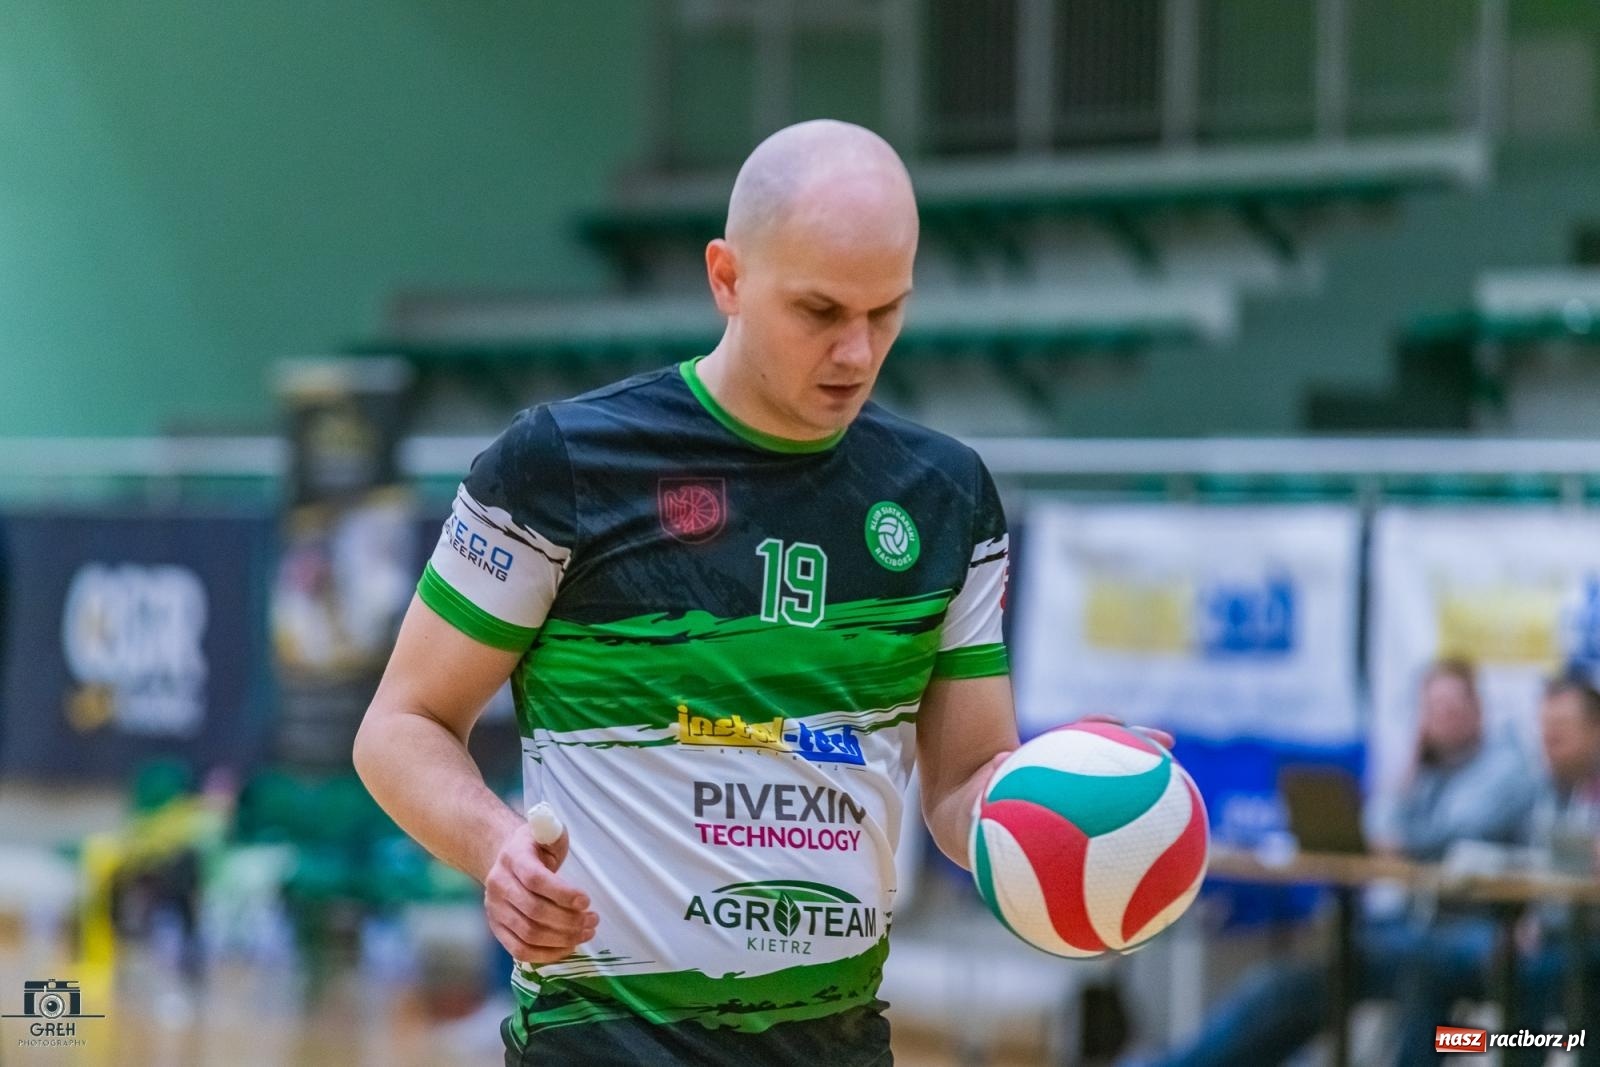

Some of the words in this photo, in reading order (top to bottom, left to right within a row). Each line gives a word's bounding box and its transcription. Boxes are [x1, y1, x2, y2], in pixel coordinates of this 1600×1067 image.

[755, 538, 828, 628] 19
[694, 781, 866, 824] PIVEXIN
[695, 823, 861, 851] TECHNOLOGY
[747, 937, 812, 955] KIETRZ
